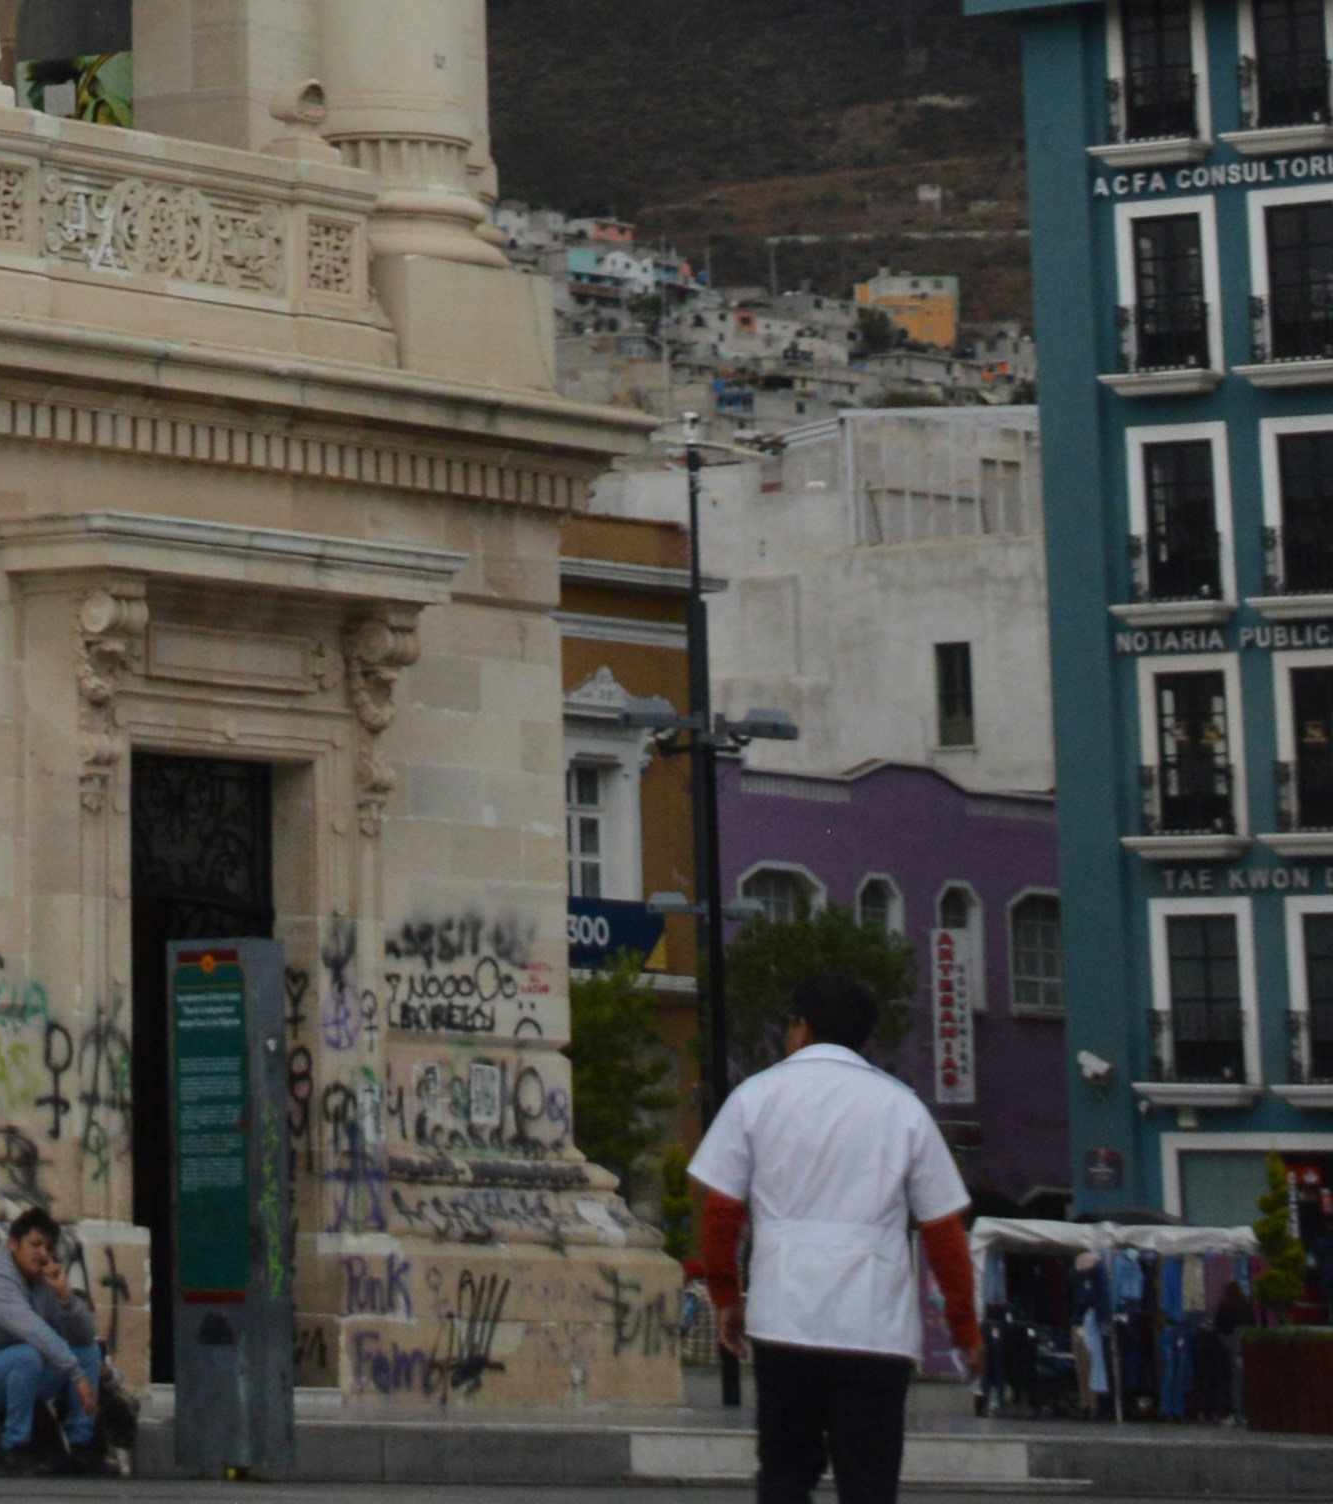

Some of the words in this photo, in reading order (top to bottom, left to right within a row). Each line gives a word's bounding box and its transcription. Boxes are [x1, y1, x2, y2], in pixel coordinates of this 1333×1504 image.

[1093, 171, 1166, 196] ACFA
[1175, 155, 1333, 189] CONSULTORI
[1115, 629, 1225, 653] NOTARIA
[1239, 625, 1333, 649] PUBLIC
[1162, 869, 1213, 890] TAE
[1227, 867, 1310, 890] KWON
